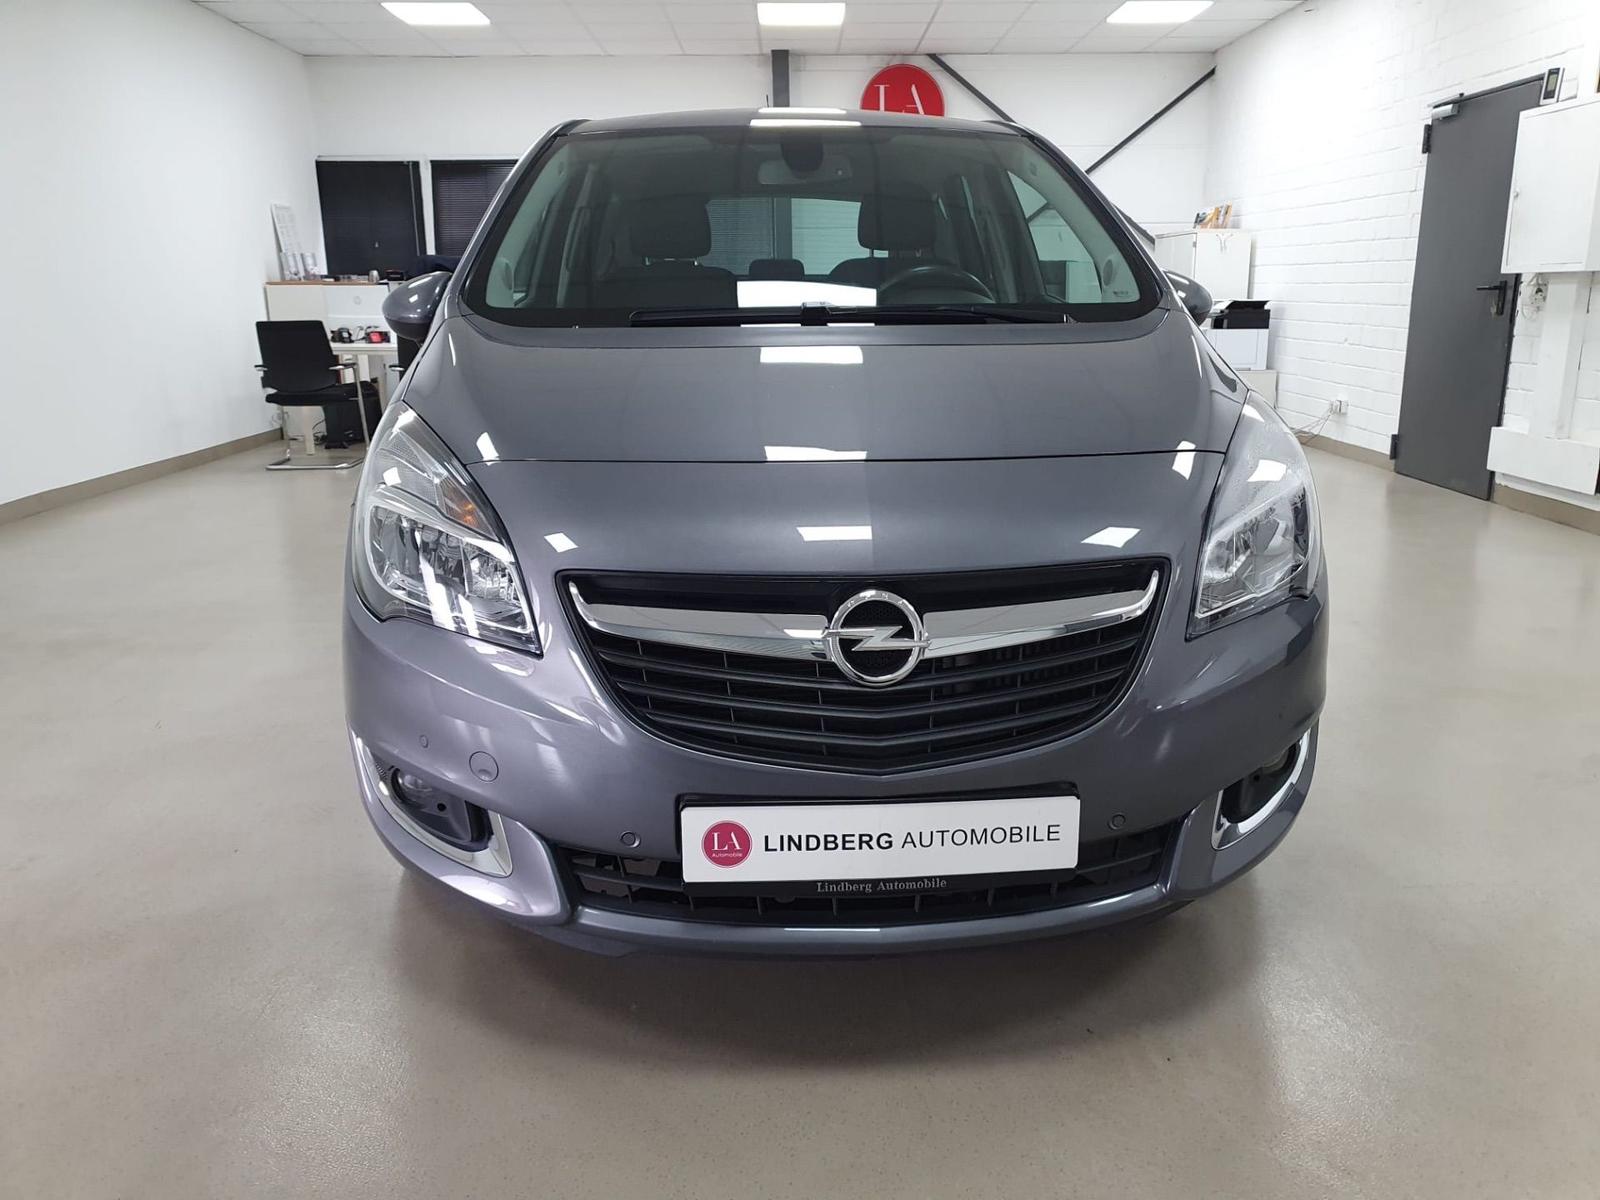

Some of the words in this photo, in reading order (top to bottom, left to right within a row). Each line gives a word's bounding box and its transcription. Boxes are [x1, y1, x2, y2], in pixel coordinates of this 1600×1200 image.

[712, 831, 742, 851] LA
[764, 832, 893, 852] LINDBERG
[901, 824, 1060, 849] AUTOMOBILE
[816, 881, 872, 893] Lindberg
[877, 877, 948, 891] Automobile
